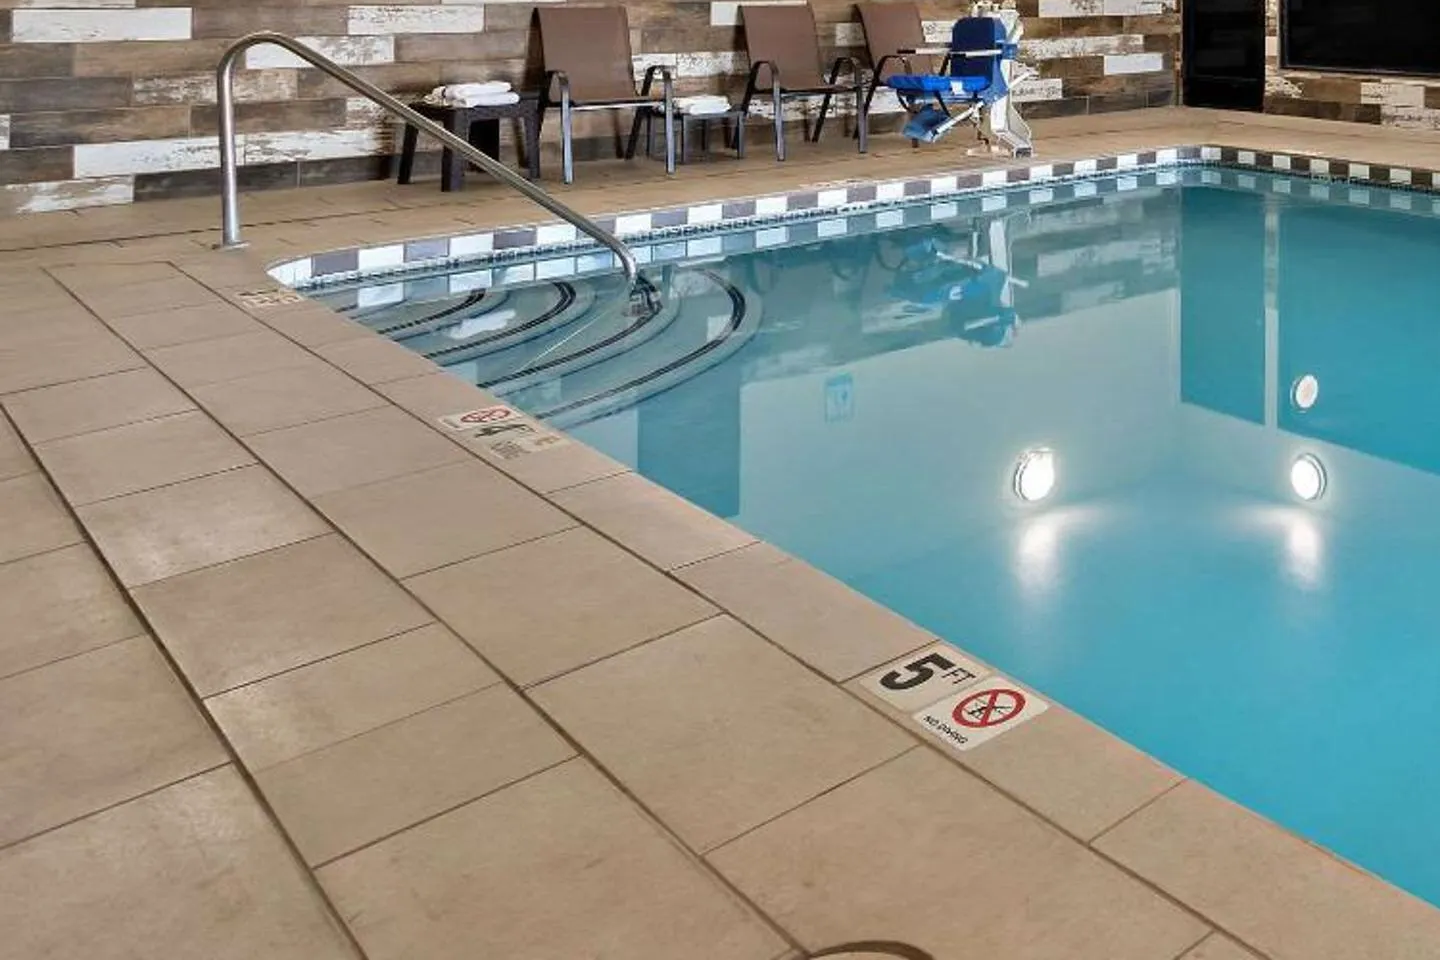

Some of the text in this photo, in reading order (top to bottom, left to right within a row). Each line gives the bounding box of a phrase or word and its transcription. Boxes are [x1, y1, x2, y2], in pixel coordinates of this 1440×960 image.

[880, 652, 976, 690] 5 FT
[923, 715, 939, 727] NO
